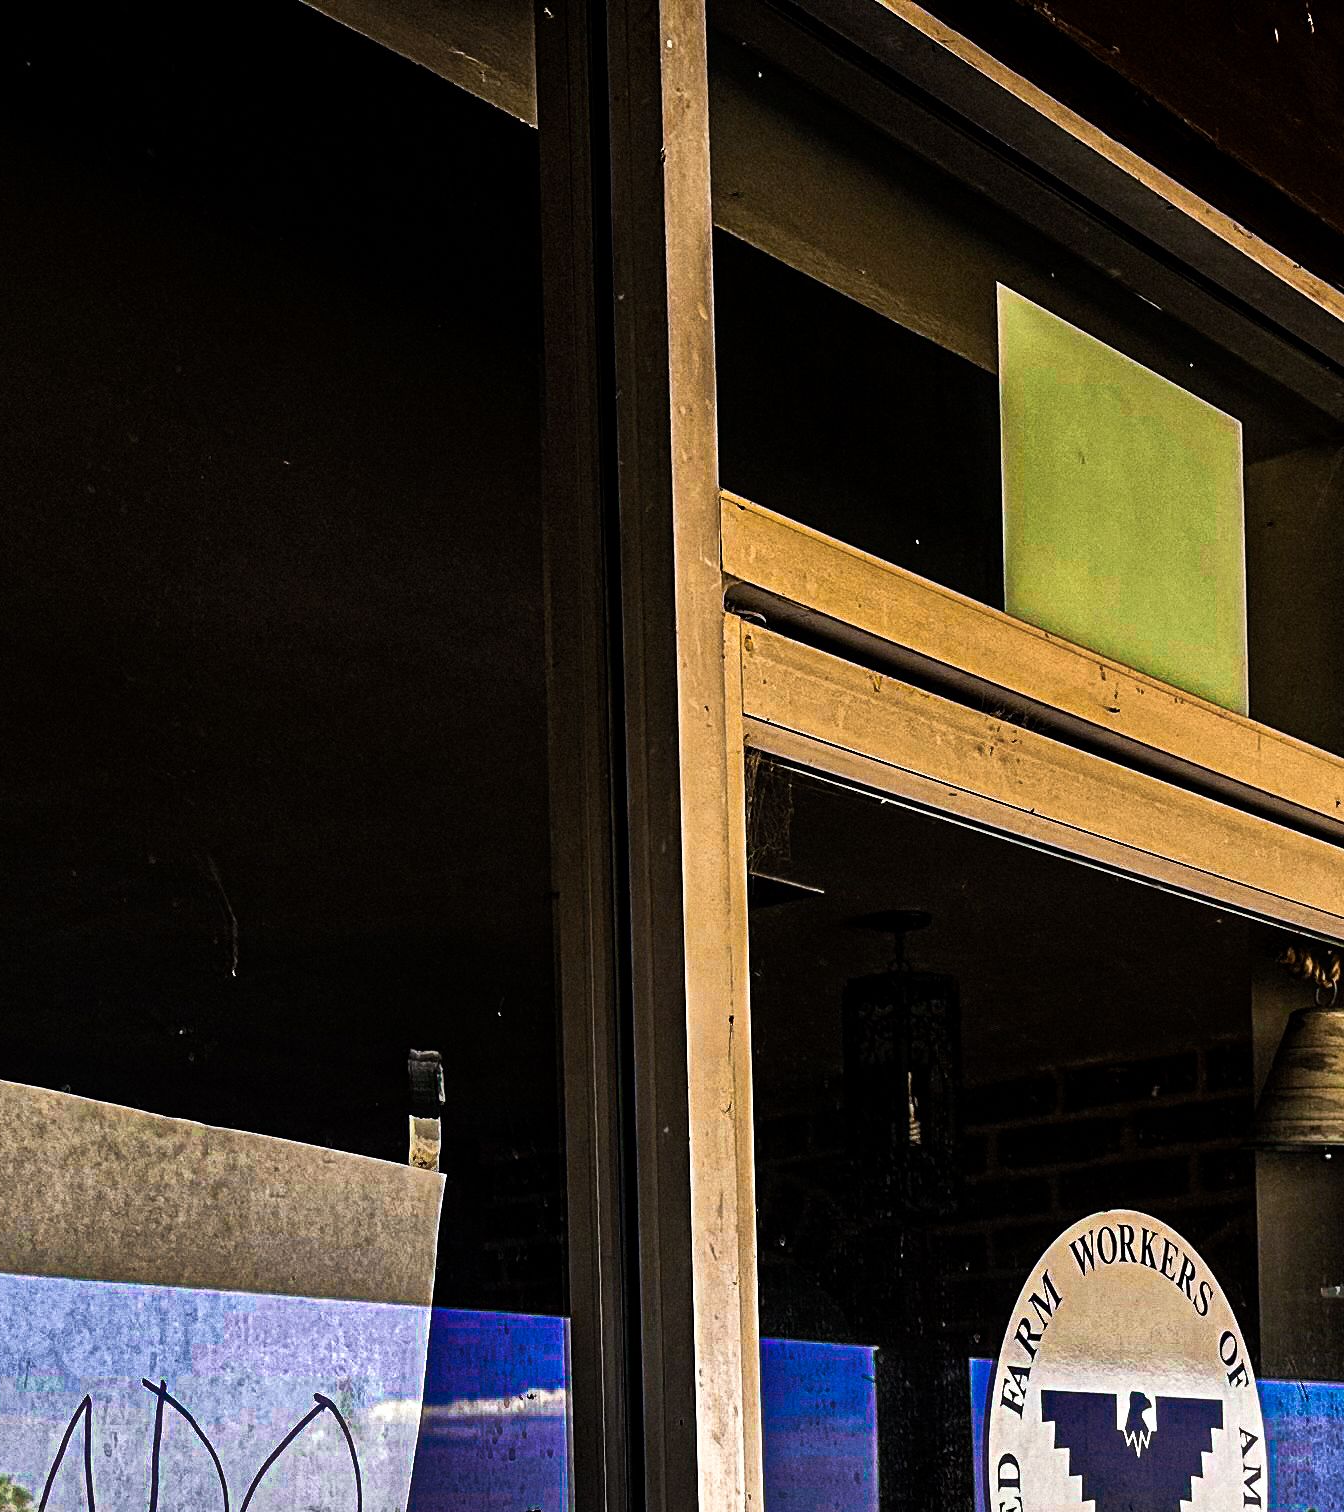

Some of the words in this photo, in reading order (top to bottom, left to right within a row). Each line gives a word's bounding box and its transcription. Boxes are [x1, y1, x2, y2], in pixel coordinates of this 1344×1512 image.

[1000, 1270, 1063, 1419] FARM
[1069, 1224, 1214, 1317] WORKERS
[1218, 1330, 1250, 1390] OF
